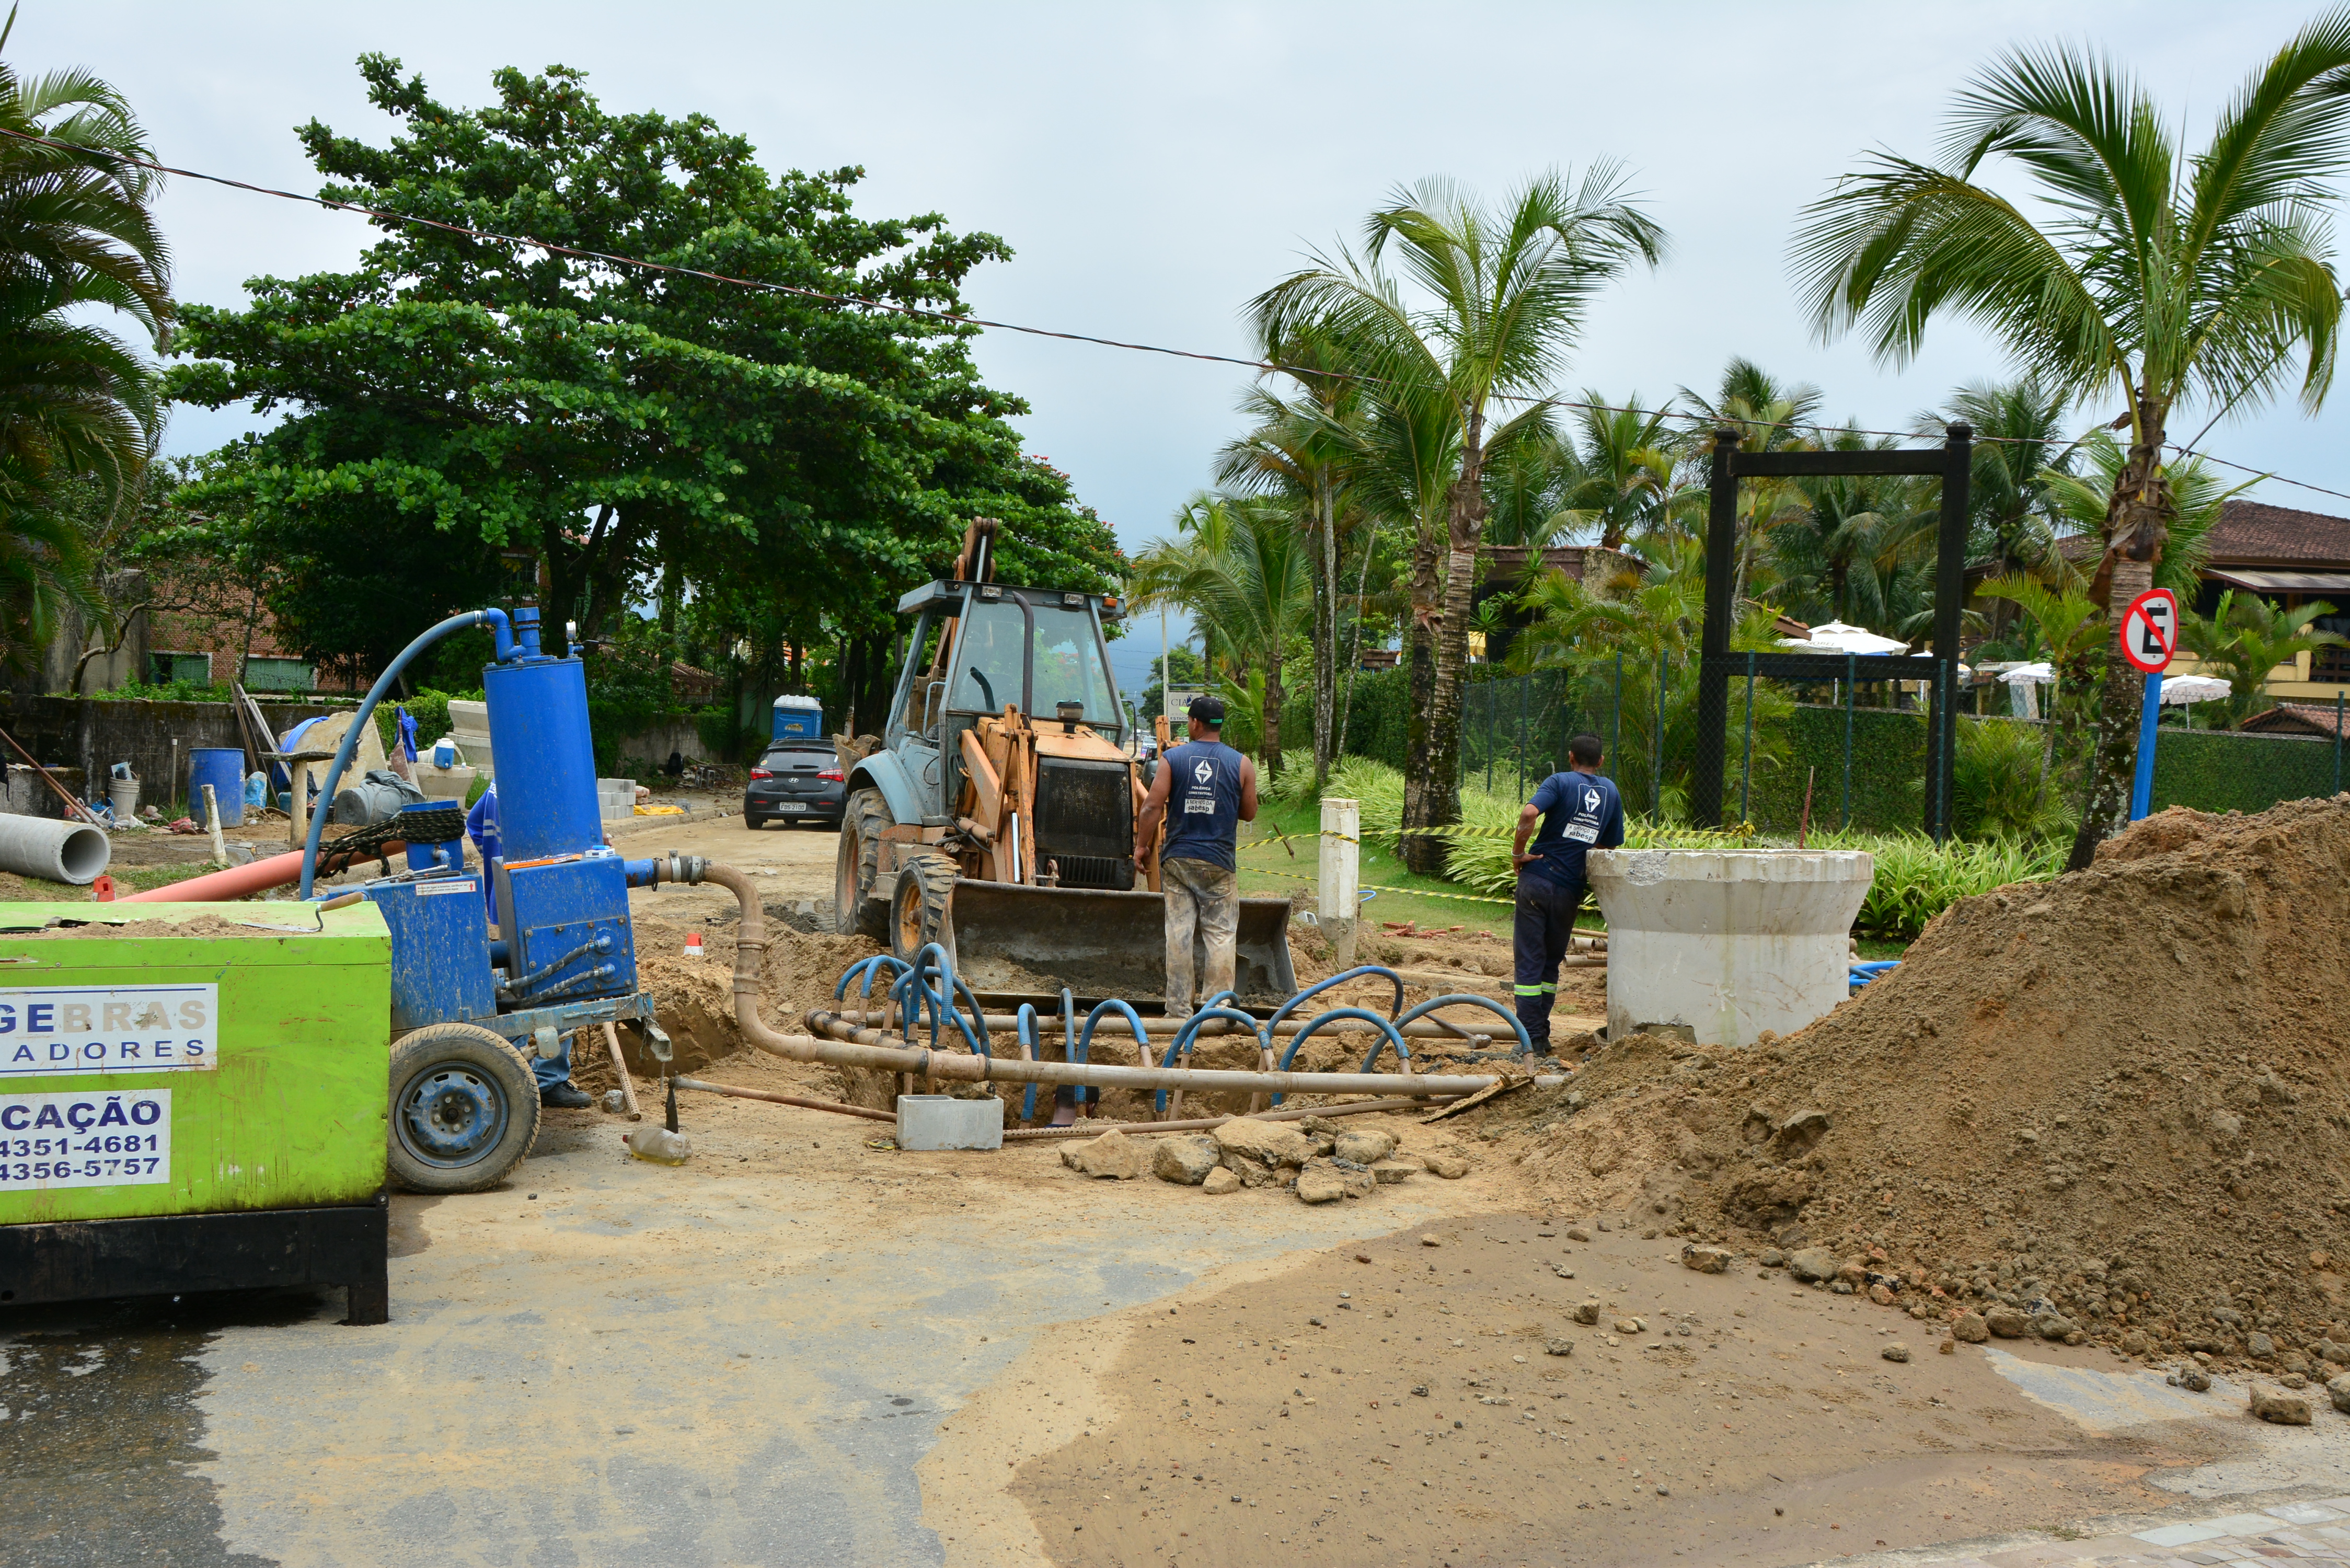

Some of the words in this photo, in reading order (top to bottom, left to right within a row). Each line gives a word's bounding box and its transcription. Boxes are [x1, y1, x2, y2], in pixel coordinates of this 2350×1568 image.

[1573, 817, 1599, 826] CONSRUTORA
[1568, 831, 1593, 841] sabesp
[11, 1039, 204, 1062] ADORES
[1, 1096, 161, 1135] CAÇÃO
